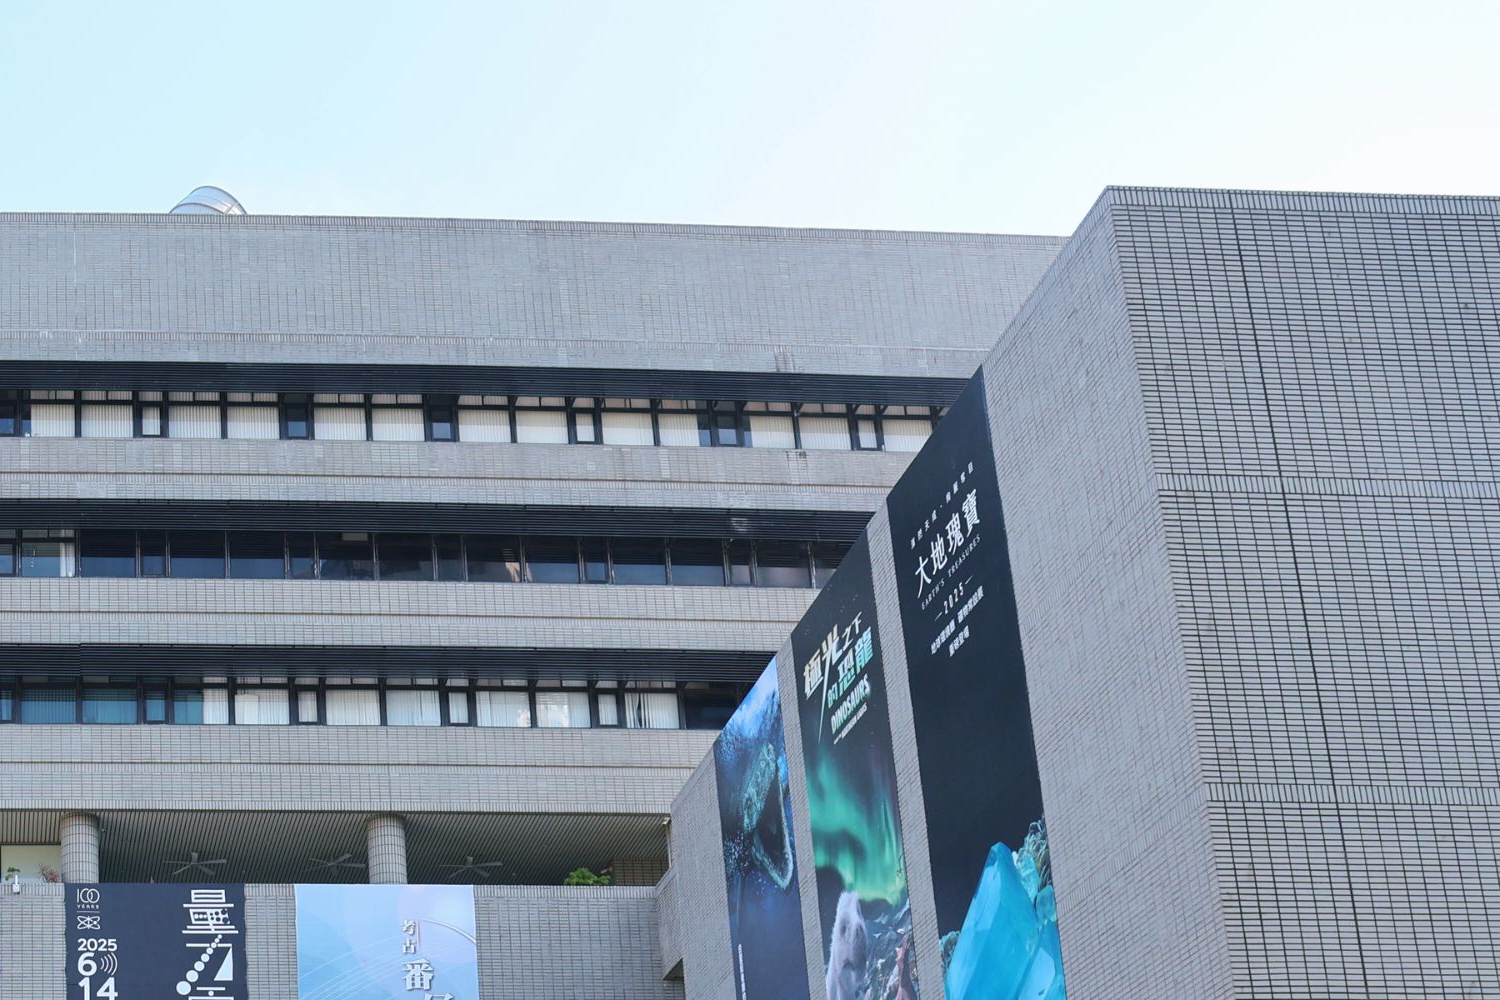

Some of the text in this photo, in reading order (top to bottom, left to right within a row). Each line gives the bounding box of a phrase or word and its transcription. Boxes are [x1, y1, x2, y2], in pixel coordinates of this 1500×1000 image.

[915, 489, 980, 599] 大地瑰寶
[921, 534, 981, 610] EARTH'S TREASURES
[831, 673, 871, 735] DINOSAURS
[77, 938, 118, 952] 2025
[401, 919, 417, 955] 考古
[77, 952, 98, 977] 6
